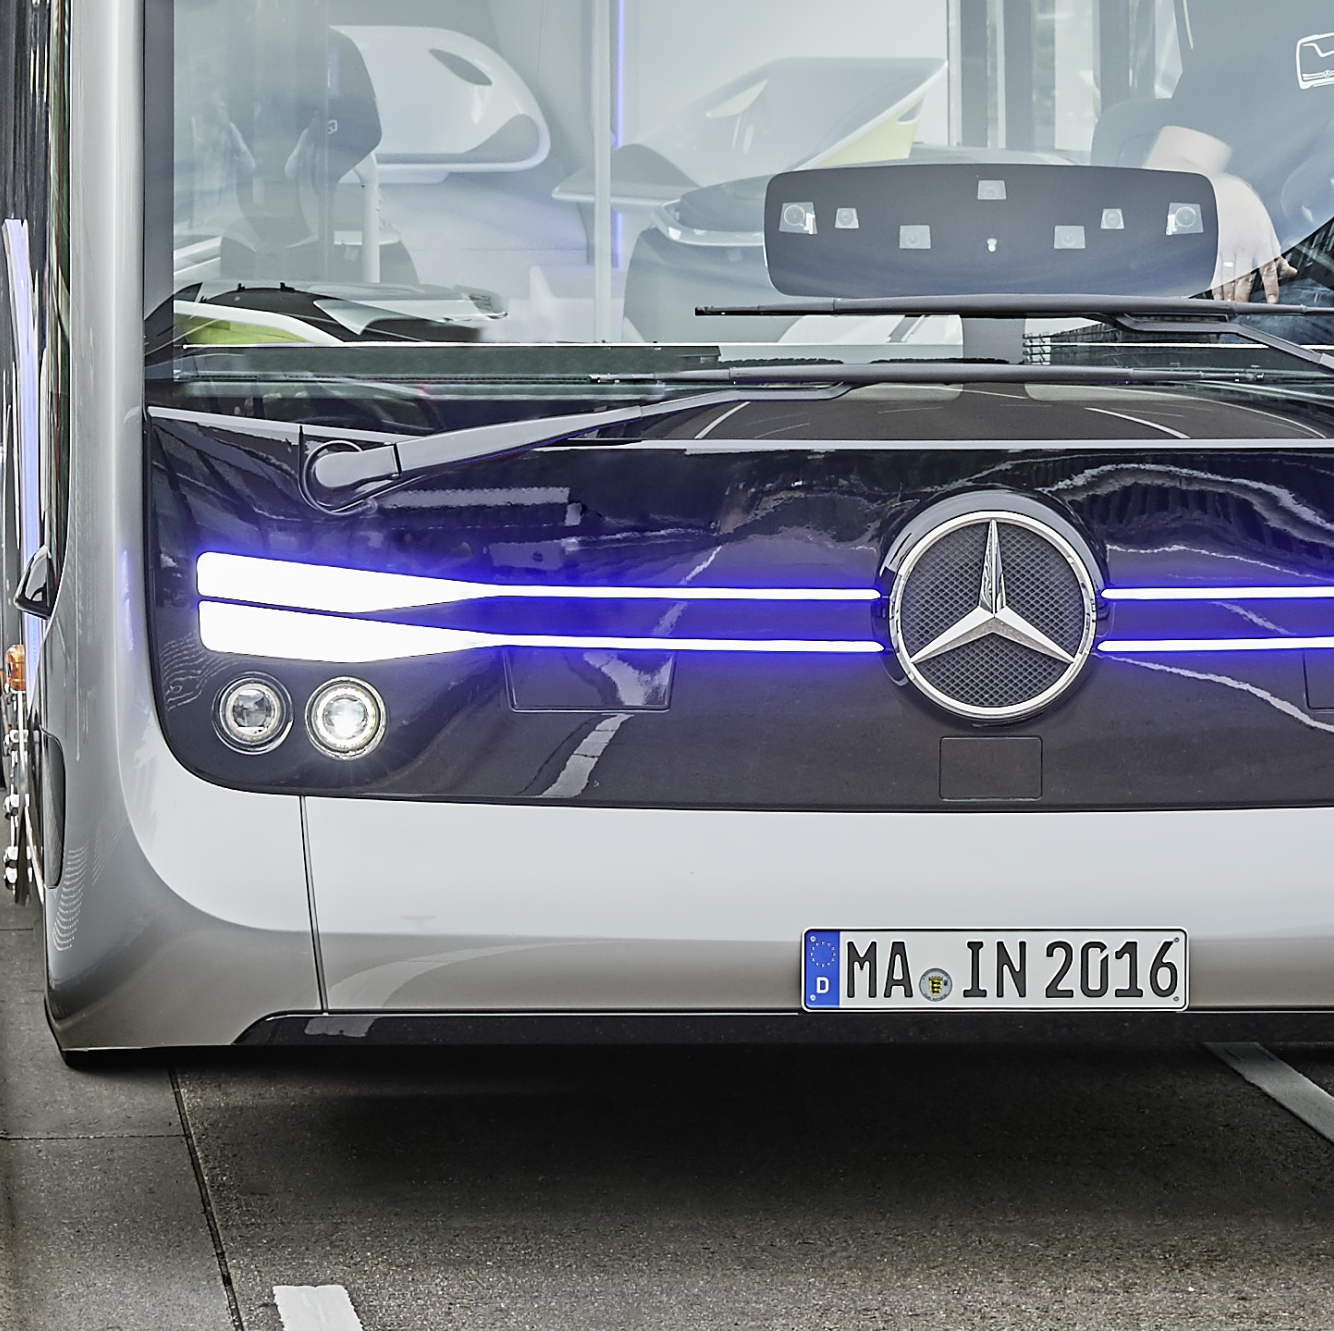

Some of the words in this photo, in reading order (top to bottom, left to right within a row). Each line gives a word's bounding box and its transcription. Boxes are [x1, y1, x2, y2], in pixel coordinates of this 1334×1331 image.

[815, 976, 830, 995] D
[846, 940, 914, 999] MA
[962, 940, 1027, 999] IN
[1045, 940, 1180, 999] 2016
